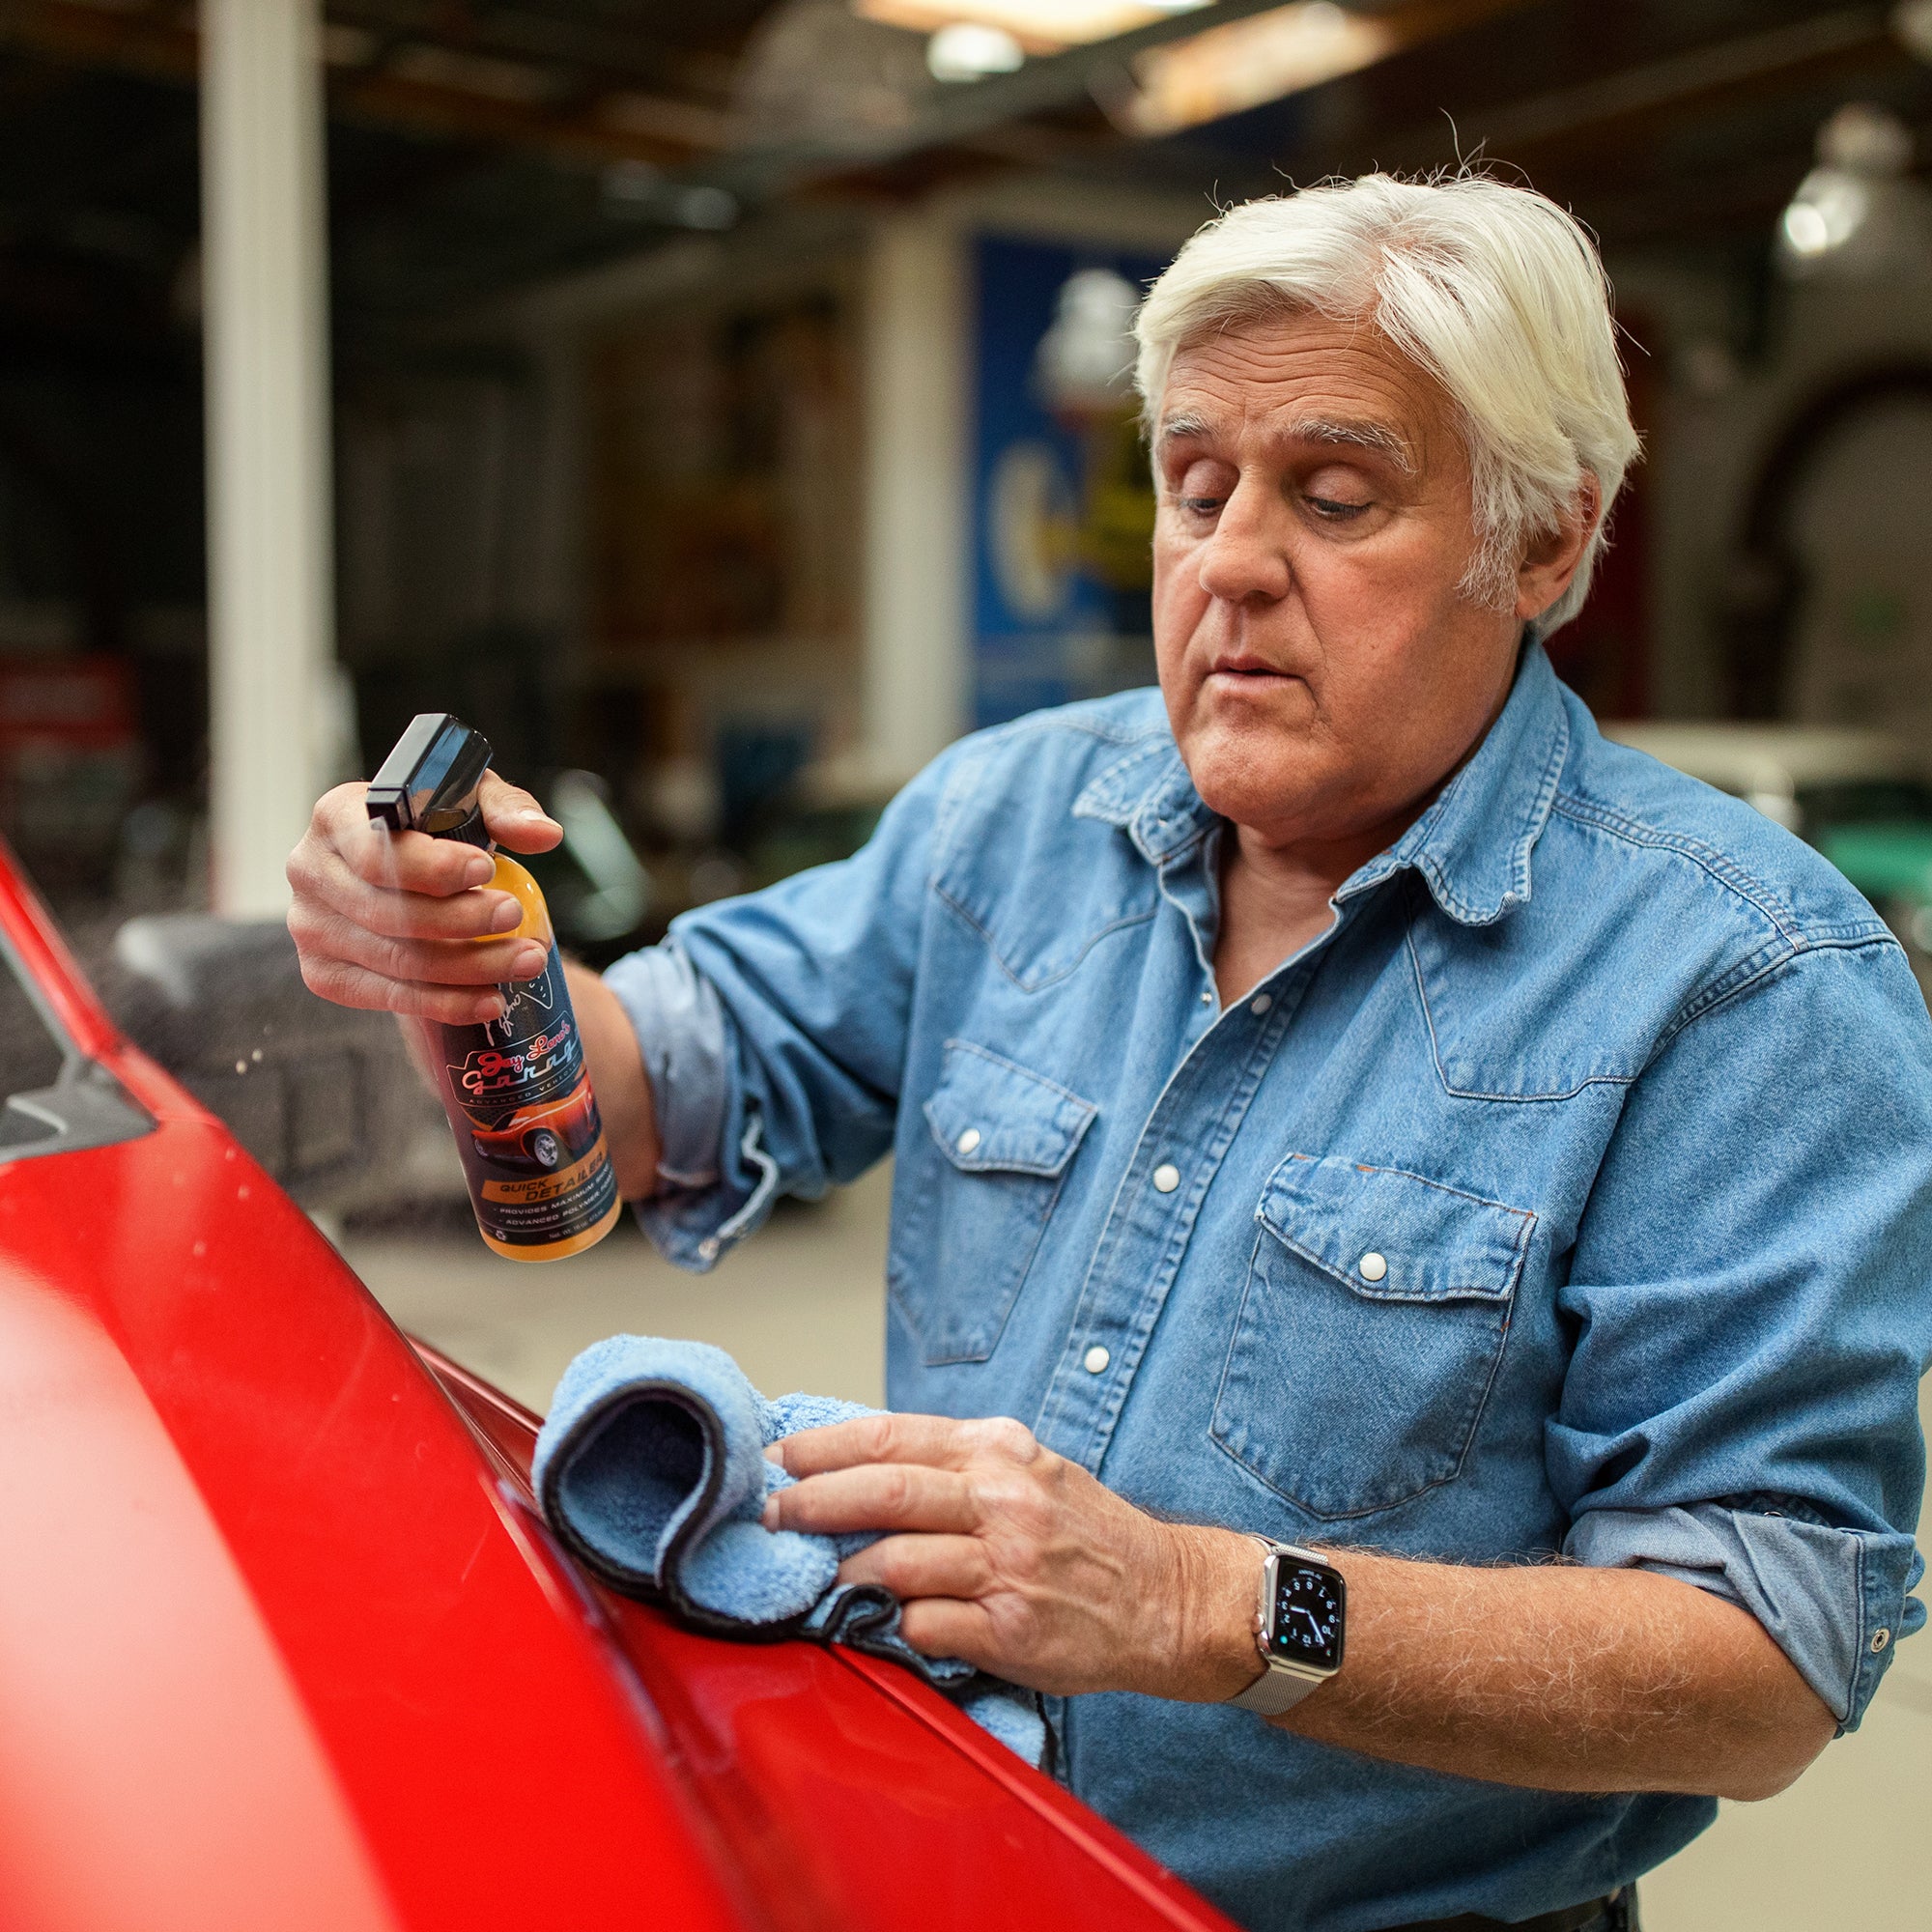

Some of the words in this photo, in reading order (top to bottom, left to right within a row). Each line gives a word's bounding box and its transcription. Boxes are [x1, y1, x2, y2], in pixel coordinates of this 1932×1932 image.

[477, 1052, 525, 1073] Jay
[526, 1019, 571, 1061] Leno's
[499, 1179, 548, 1193] QUICK
[525, 1151, 603, 1202] DETAILER
[499, 1207, 548, 1215] PROVIDES
[551, 1182, 594, 1209] MAXIMUM
[505, 1214, 559, 1226] ADVANCED
